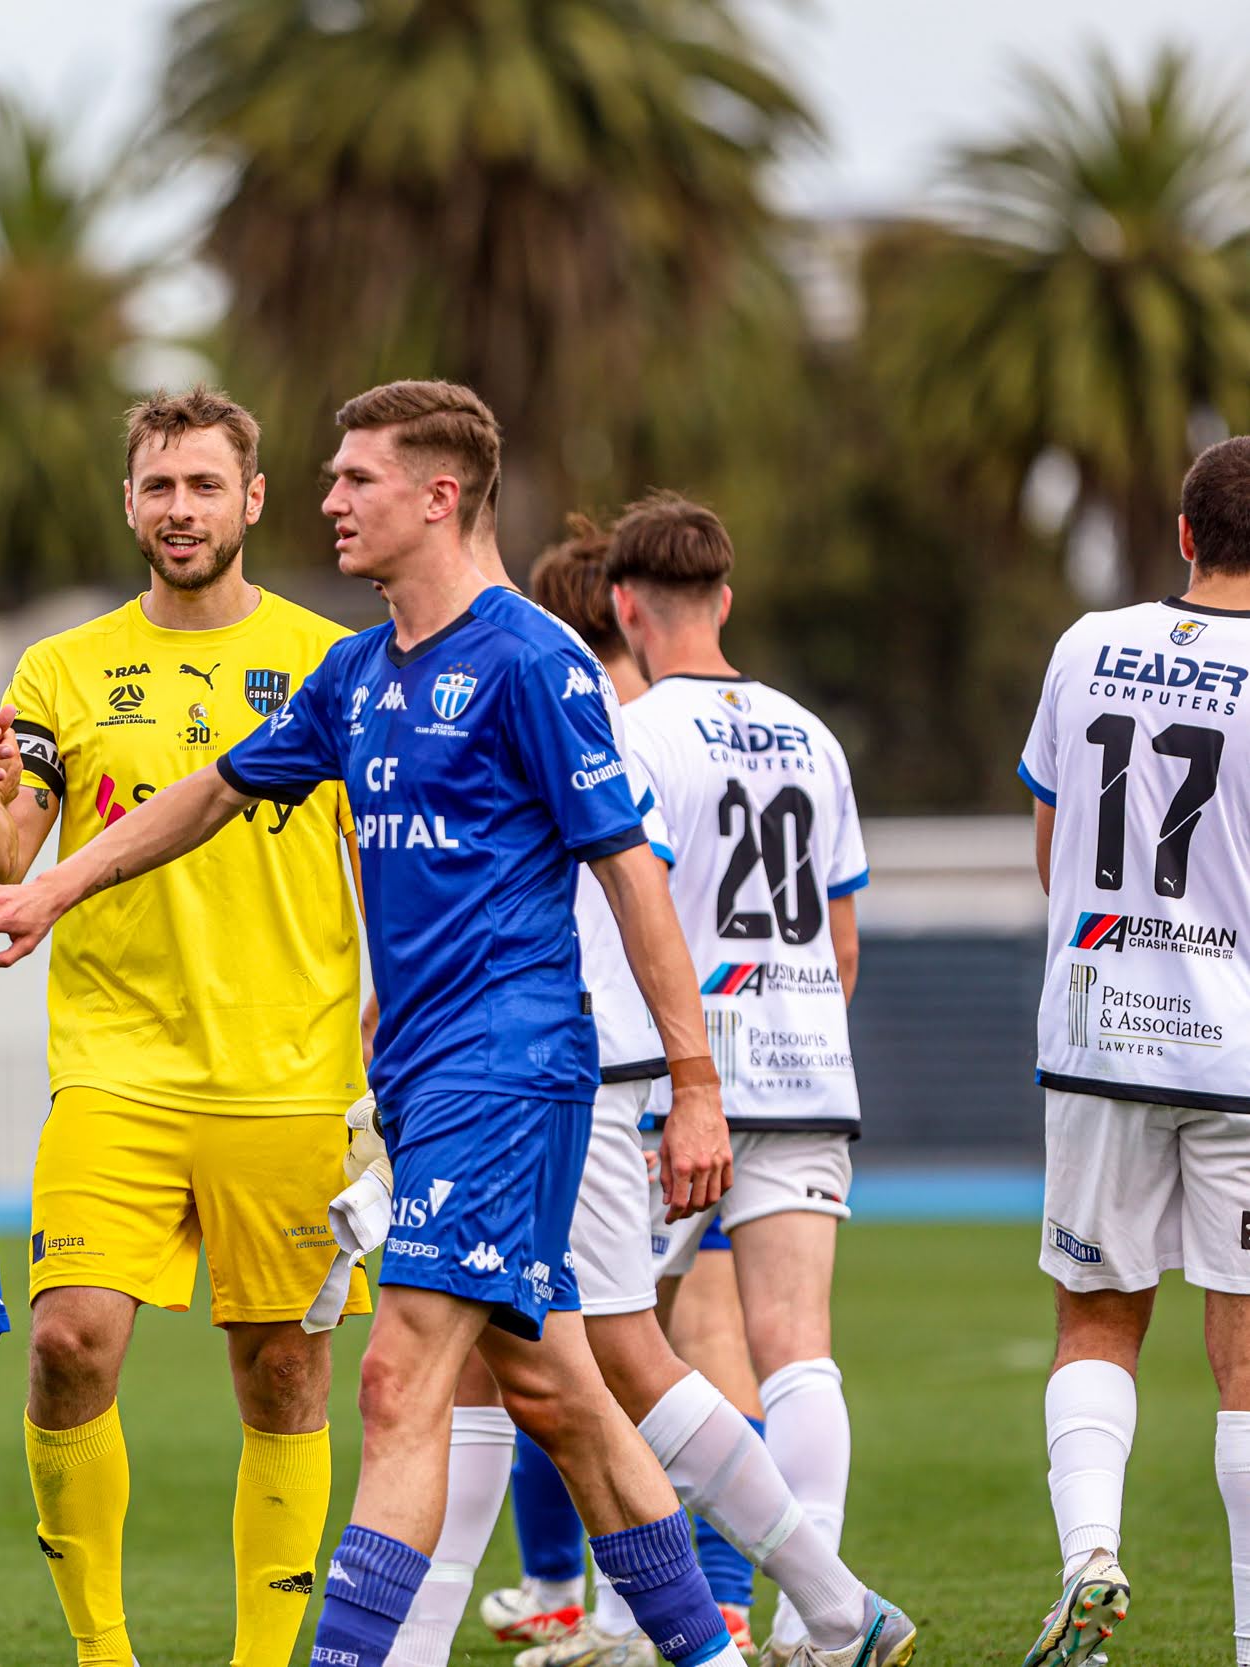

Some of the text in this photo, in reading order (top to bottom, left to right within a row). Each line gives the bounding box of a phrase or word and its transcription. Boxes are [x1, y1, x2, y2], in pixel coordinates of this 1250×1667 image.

[116, 663, 151, 678] RAA
[1094, 645, 1249, 698] LEADER
[248, 690, 284, 700] COMETS
[1089, 682, 1237, 716] COMPUTERS
[186, 727, 211, 744] 30
[694, 718, 813, 756] LEADER
[581, 751, 606, 768] New
[711, 749, 815, 774] COUTERS
[366, 757, 399, 792] CF
[1086, 712, 1225, 899] 17
[717, 777, 824, 946] 20
[1092, 915, 1237, 953] AUSTRALIAN
[1129, 937, 1221, 958] CRASH REPAIRS
[1102, 986, 1191, 1014] Patsouris
[1100, 1009, 1223, 1040] & Associates
[750, 1027, 827, 1047] Patsouris
[751, 1049, 854, 1068] & Associates
[1099, 1041, 1163, 1056] LAWYERS
[750, 1078, 812, 1088] LAWYERS
[48, 1235, 85, 1250] ispira
[269, 1578, 312, 1594] adida
